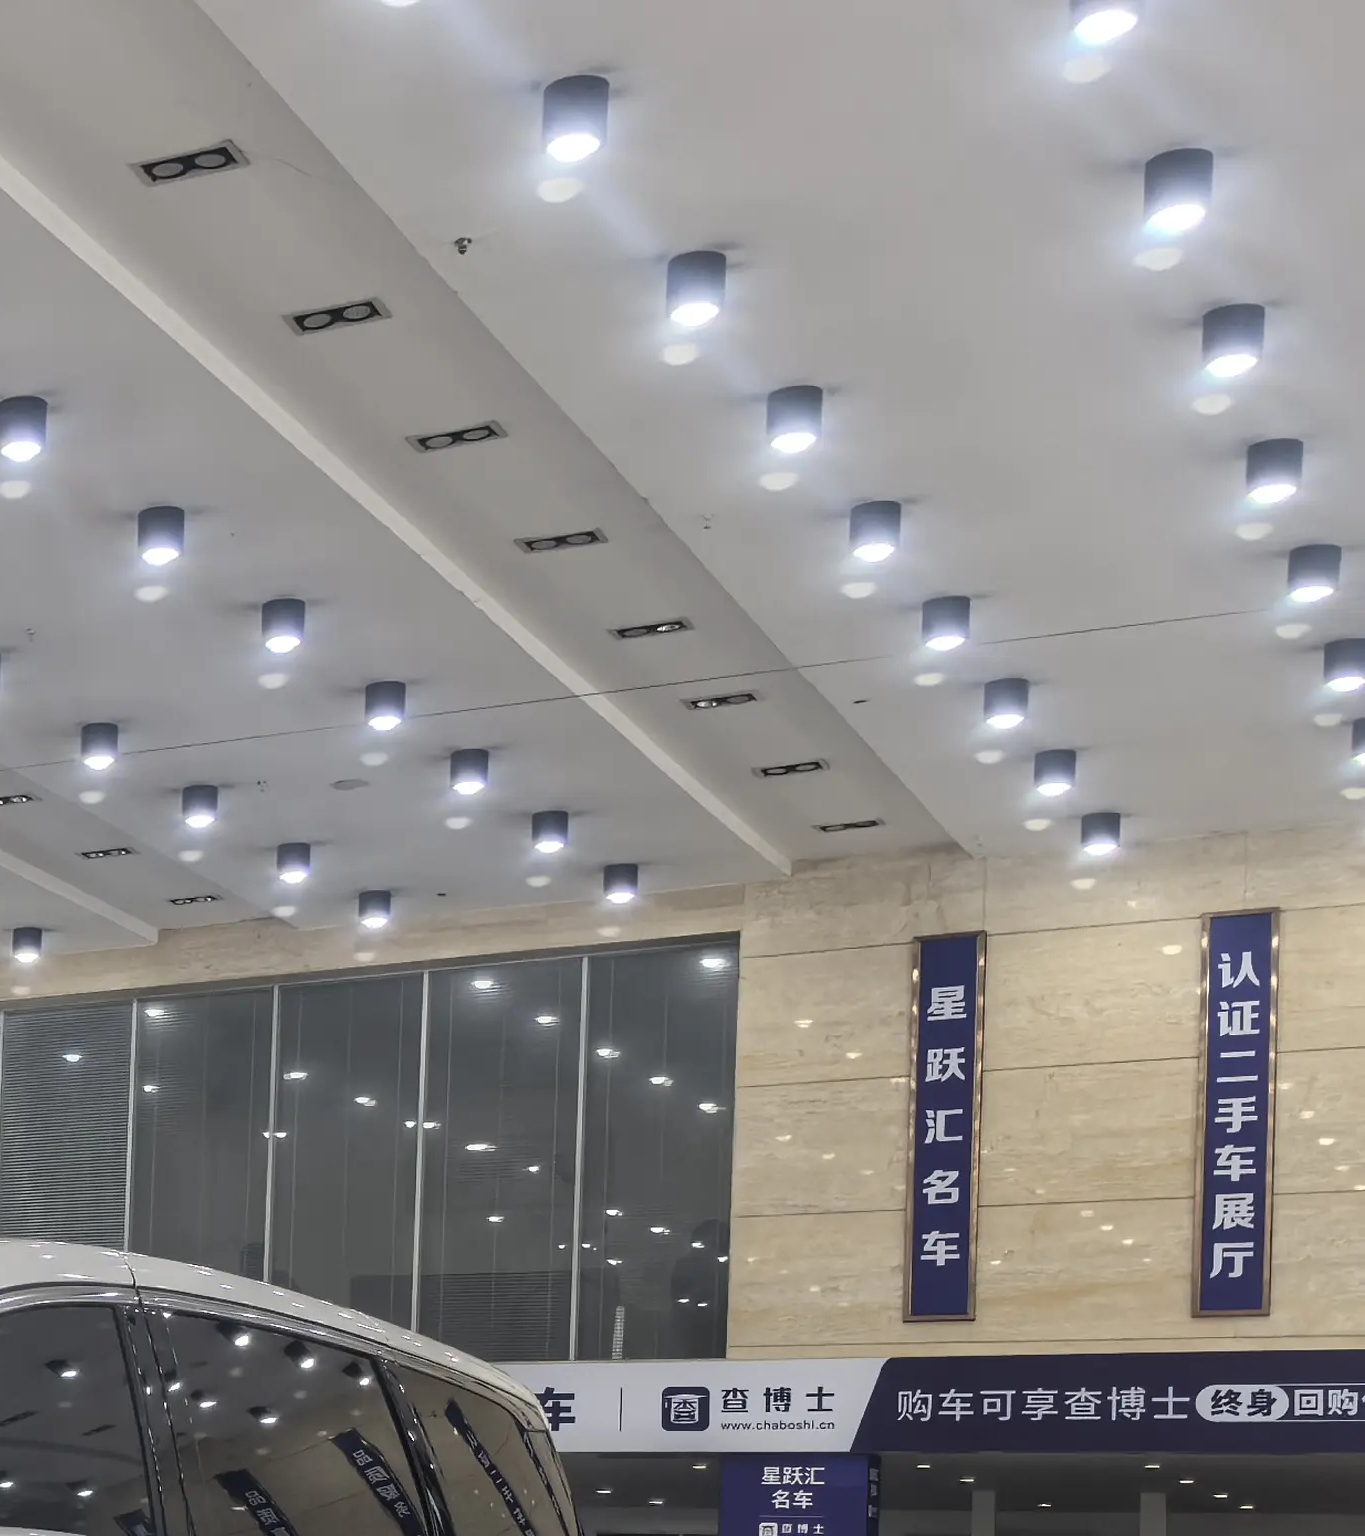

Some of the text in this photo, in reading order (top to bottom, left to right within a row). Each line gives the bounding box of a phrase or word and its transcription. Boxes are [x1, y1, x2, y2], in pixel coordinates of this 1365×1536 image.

[920, 985, 968, 1266] 星跃汇名车
[1209, 952, 1261, 1279] 认证二手车展厅
[533, 1386, 576, 1431] 车
[721, 1386, 835, 1413] 查博士
[896, 1385, 1365, 1422] 购车可享查博士终身回购
[760, 1466, 826, 1486] 星跃汇
[771, 1489, 814, 1509] 名车
